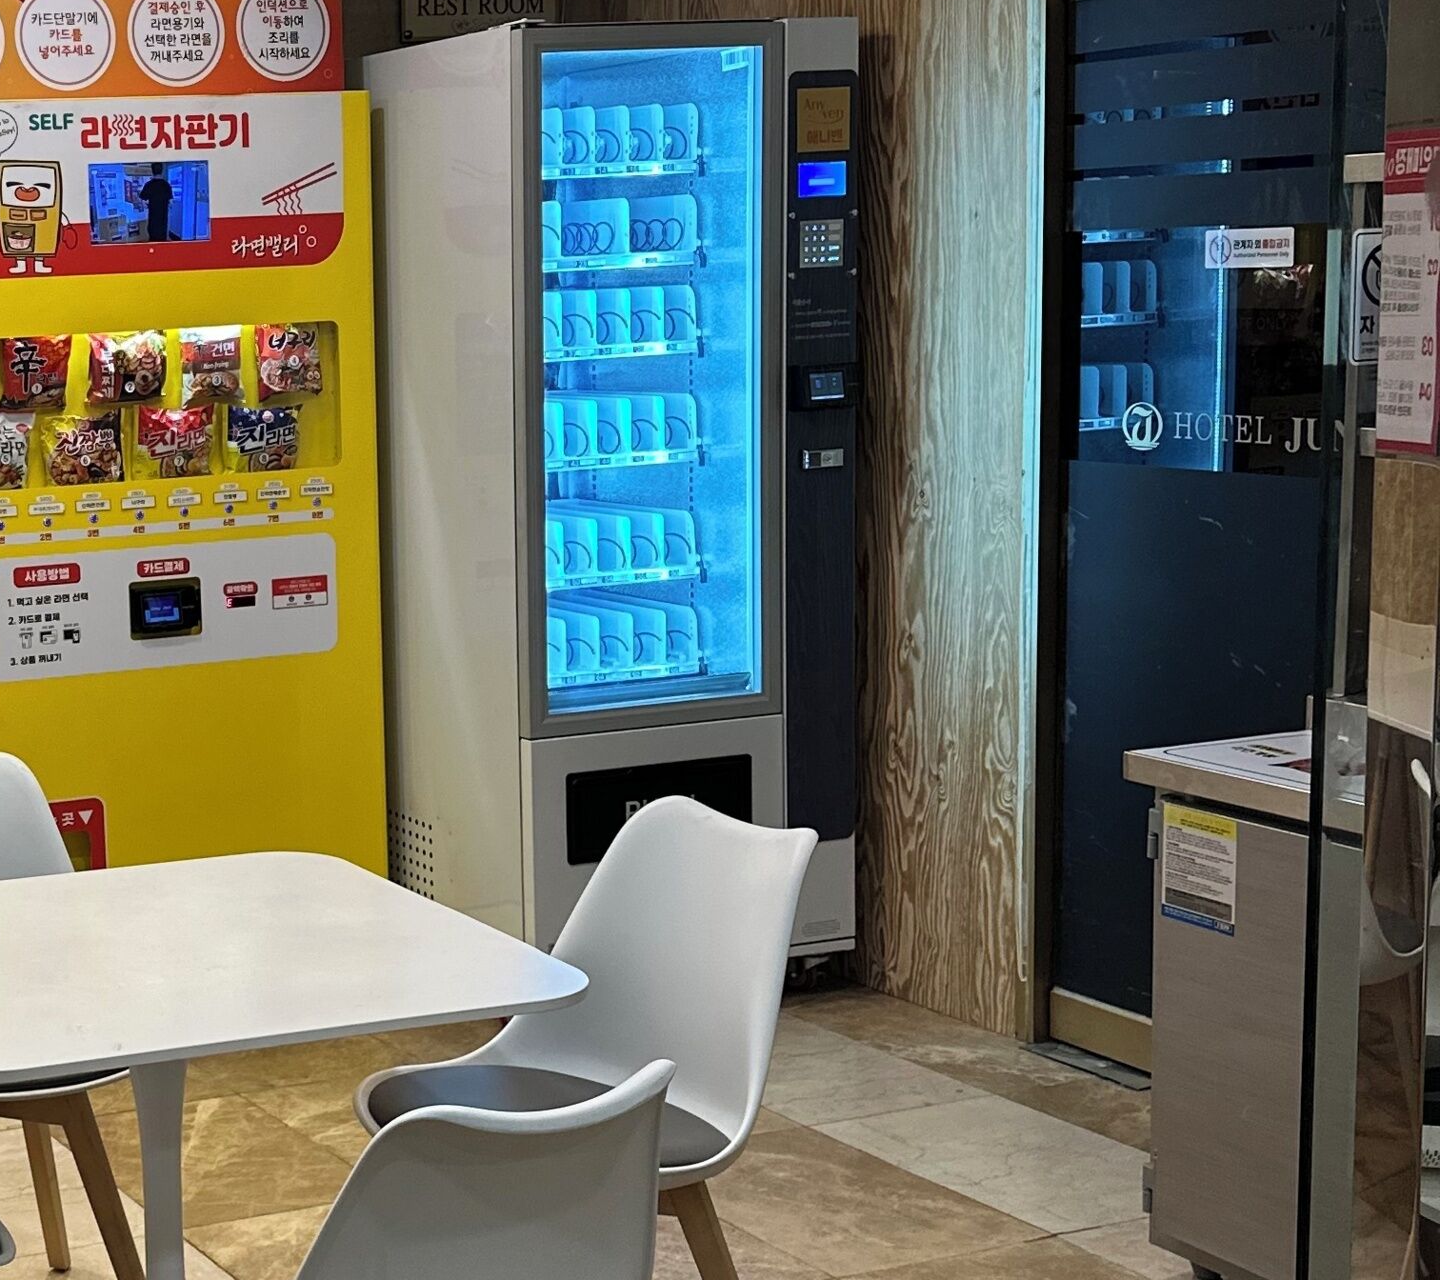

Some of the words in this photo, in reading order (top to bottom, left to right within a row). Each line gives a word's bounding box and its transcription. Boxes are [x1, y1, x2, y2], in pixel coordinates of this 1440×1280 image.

[148, 1, 191, 15] 결제승인
[195, 1, 206, 13] 후
[256, 0, 309, 13] 인덕션으로
[31, 12, 98, 26] 카드단말기에
[150, 17, 204, 31] 라면용기와
[263, 14, 304, 28] 이동하여
[49, 28, 83, 42] 카드를
[144, 34, 177, 48] 선택한
[180, 32, 212, 47] 라면을
[268, 31, 299, 44] 조리를
[39, 45, 95, 60] 넣어주세요
[150, 50, 204, 63] 꺼내주세요
[259, 47, 311, 60] 시작하세요
[28, 113, 74, 131] SELF
[80, 112, 250, 150] 라면자판기
[231, 234, 299, 259] 라면밸리
[268, 330, 318, 352] 너구리
[210, 341, 236, 357] 건면
[10, 341, 47, 394] 辛
[1173, 411, 1272, 445] HOTEL
[148, 425, 207, 459] 진라면
[238, 422, 297, 455] 진라면
[143, 560, 184, 574] 카드결제
[24, 567, 70, 582] 사용방법
[16, 597, 33, 606] 먹고
[35, 595, 51, 605] 싶은
[53, 594, 70, 603] 라면
[72, 592, 88, 601] 선택
[18, 614, 42, 624] 카드로
[20, 655, 36, 664] 상품
[38, 653, 62, 663] 꺼내기
[62, 812, 75, 827] 곳
